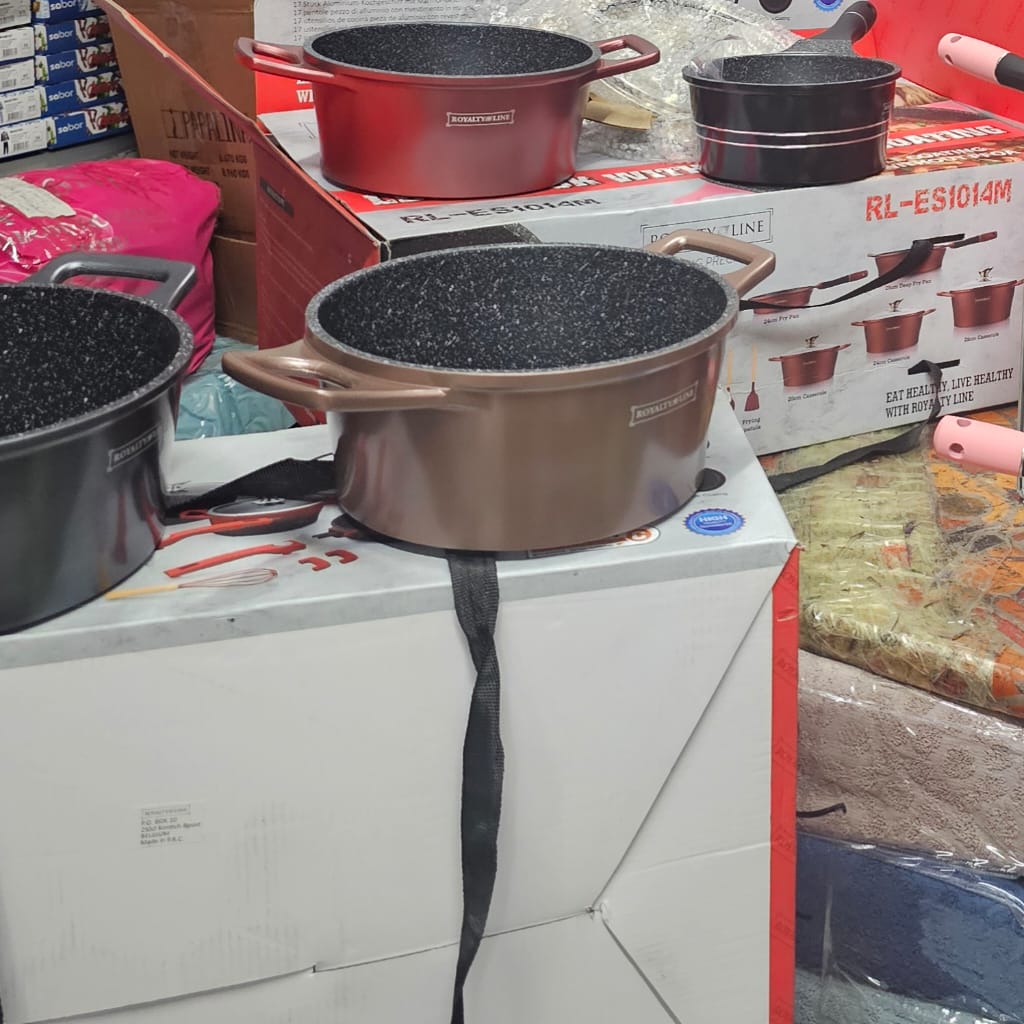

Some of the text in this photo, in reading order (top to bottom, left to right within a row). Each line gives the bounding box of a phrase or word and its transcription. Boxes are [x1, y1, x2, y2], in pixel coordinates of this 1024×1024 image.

[48, 28, 74, 41] sabor
[49, 59, 74, 72] sabor
[48, 89, 74, 102] sabor
[57, 120, 84, 134] sabor
[864, 178, 1013, 221] RL-ES1014M
[400, 198, 601, 223] RL-ES1014M
[732, 220, 764, 236] LINE
[886, 390, 904, 403] EAT
[952, 377, 972, 389] LIVE
[973, 368, 1014, 386] HEALTHY
[885, 391, 974, 419] WITH ROYATY LINE
[699, 515, 728, 523] HIGH
